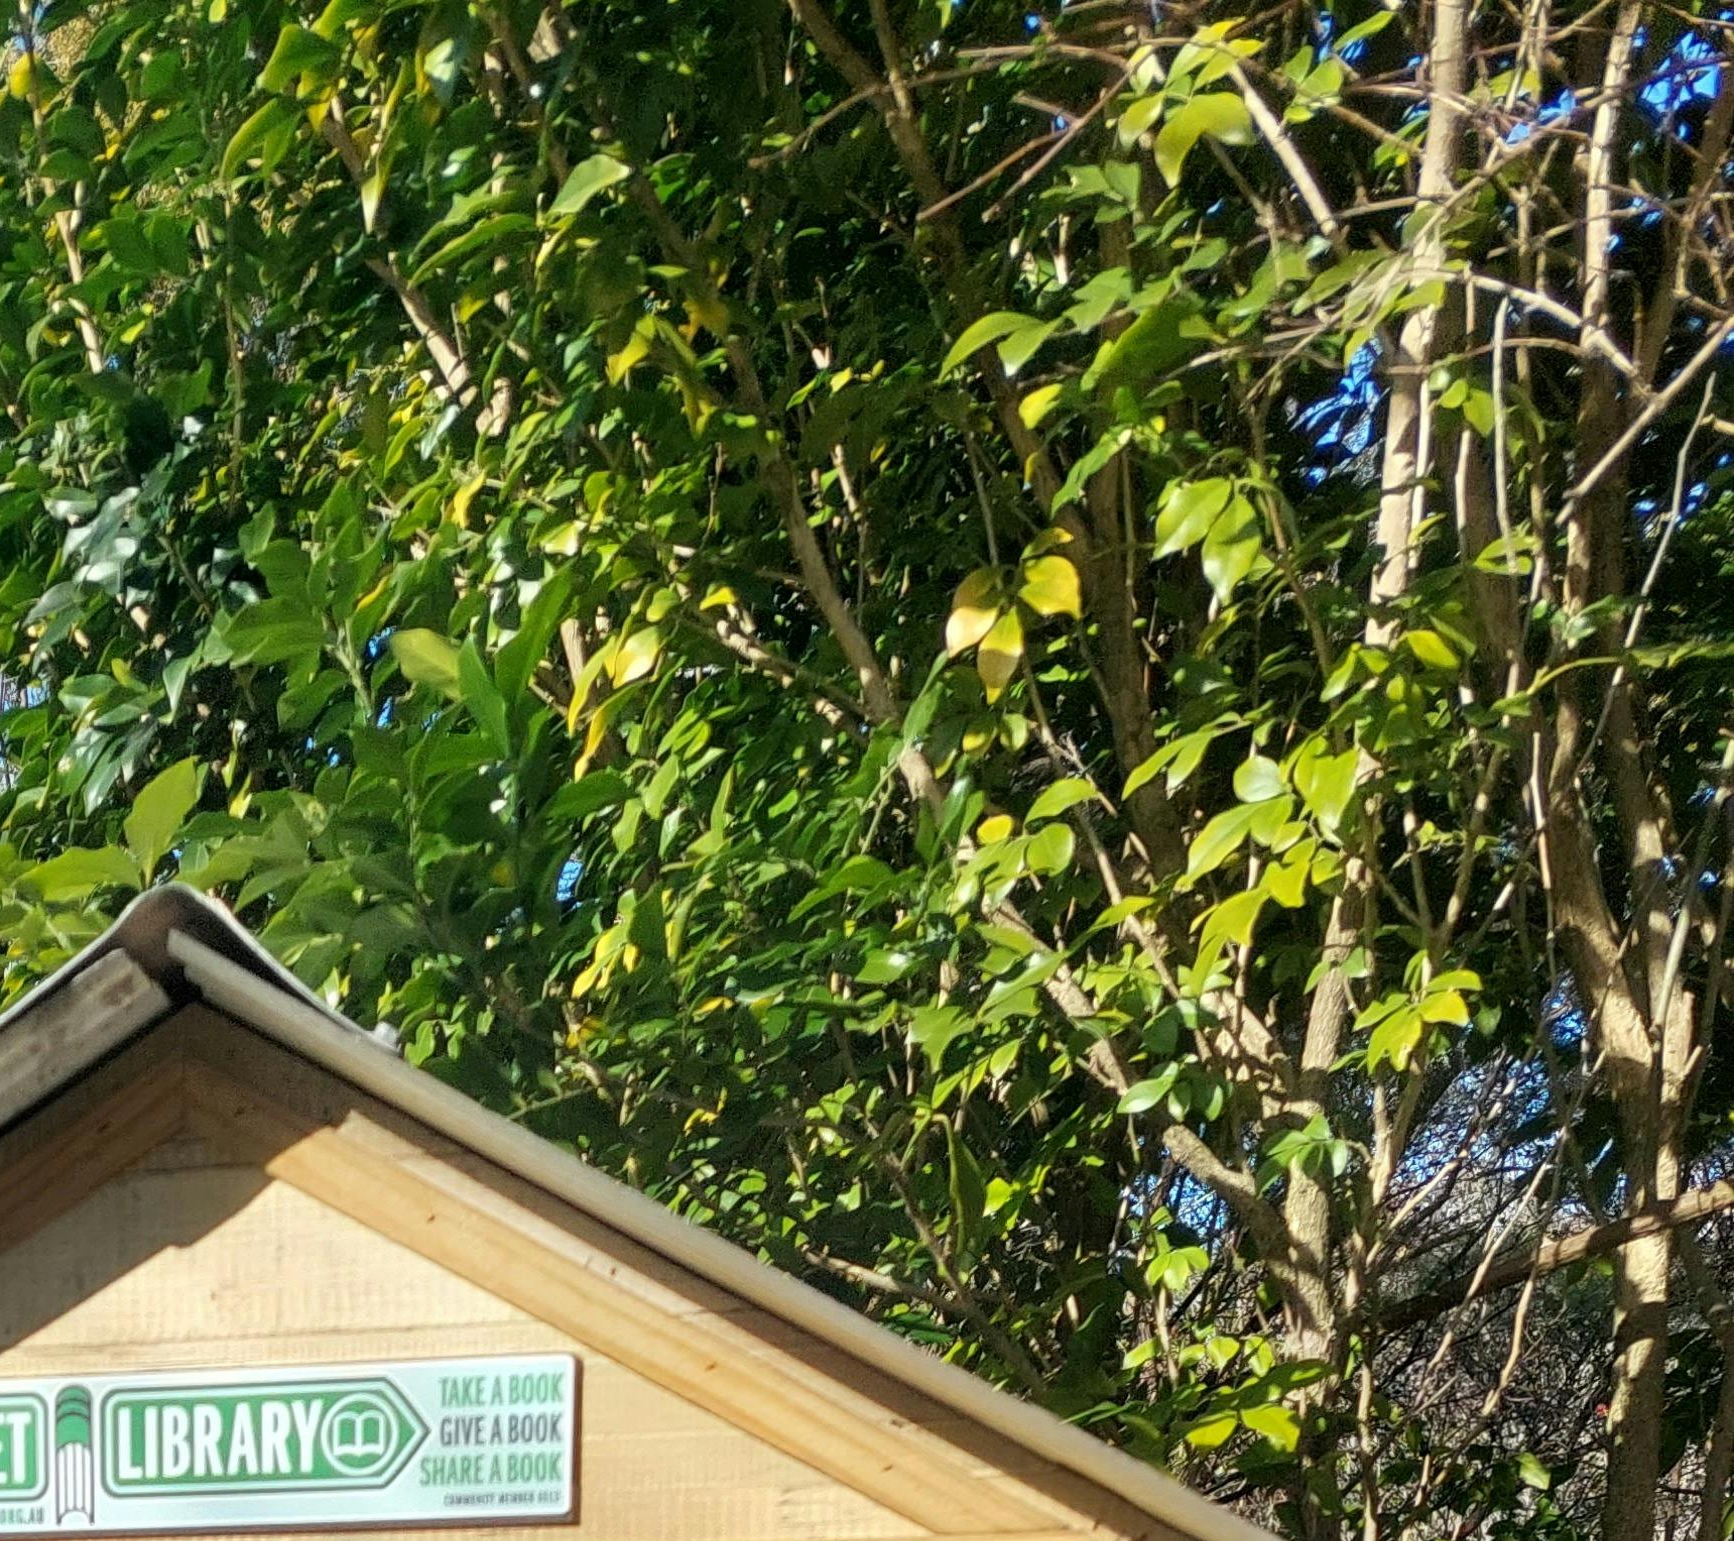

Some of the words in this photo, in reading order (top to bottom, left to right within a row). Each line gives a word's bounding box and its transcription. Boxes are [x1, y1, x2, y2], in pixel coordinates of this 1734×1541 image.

[438, 1375, 487, 1408] TAKE
[489, 1375, 504, 1407] A
[507, 1372, 565, 1404] BOOK
[117, 1398, 324, 1480] LIBRARY
[440, 1416, 488, 1447] GIVE
[489, 1414, 504, 1446] A
[507, 1412, 564, 1444] BOOK
[418, 1455, 486, 1488] SHARE
[487, 1453, 503, 1485] A
[507, 1451, 563, 1484] BOOK
